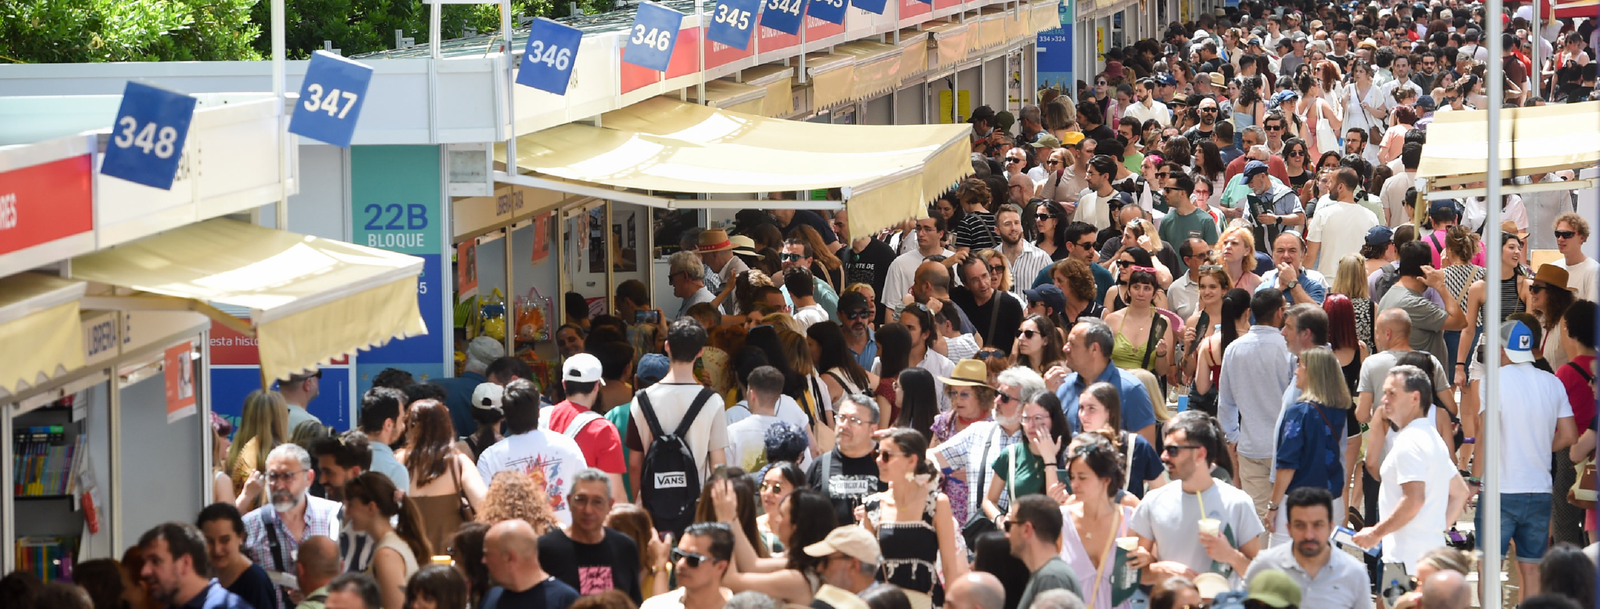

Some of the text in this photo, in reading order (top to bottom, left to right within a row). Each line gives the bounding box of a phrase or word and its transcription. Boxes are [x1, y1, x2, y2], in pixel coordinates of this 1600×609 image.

[715, 4, 751, 30] 345
[631, 24, 671, 51] 346
[528, 40, 571, 71] 346
[304, 83, 357, 120] 347
[114, 115, 178, 159] 348
[364, 203, 428, 230] 22B
[368, 233, 424, 248] BLOQUE
[210, 336, 233, 346] esta
[657, 474, 684, 485] VANS
